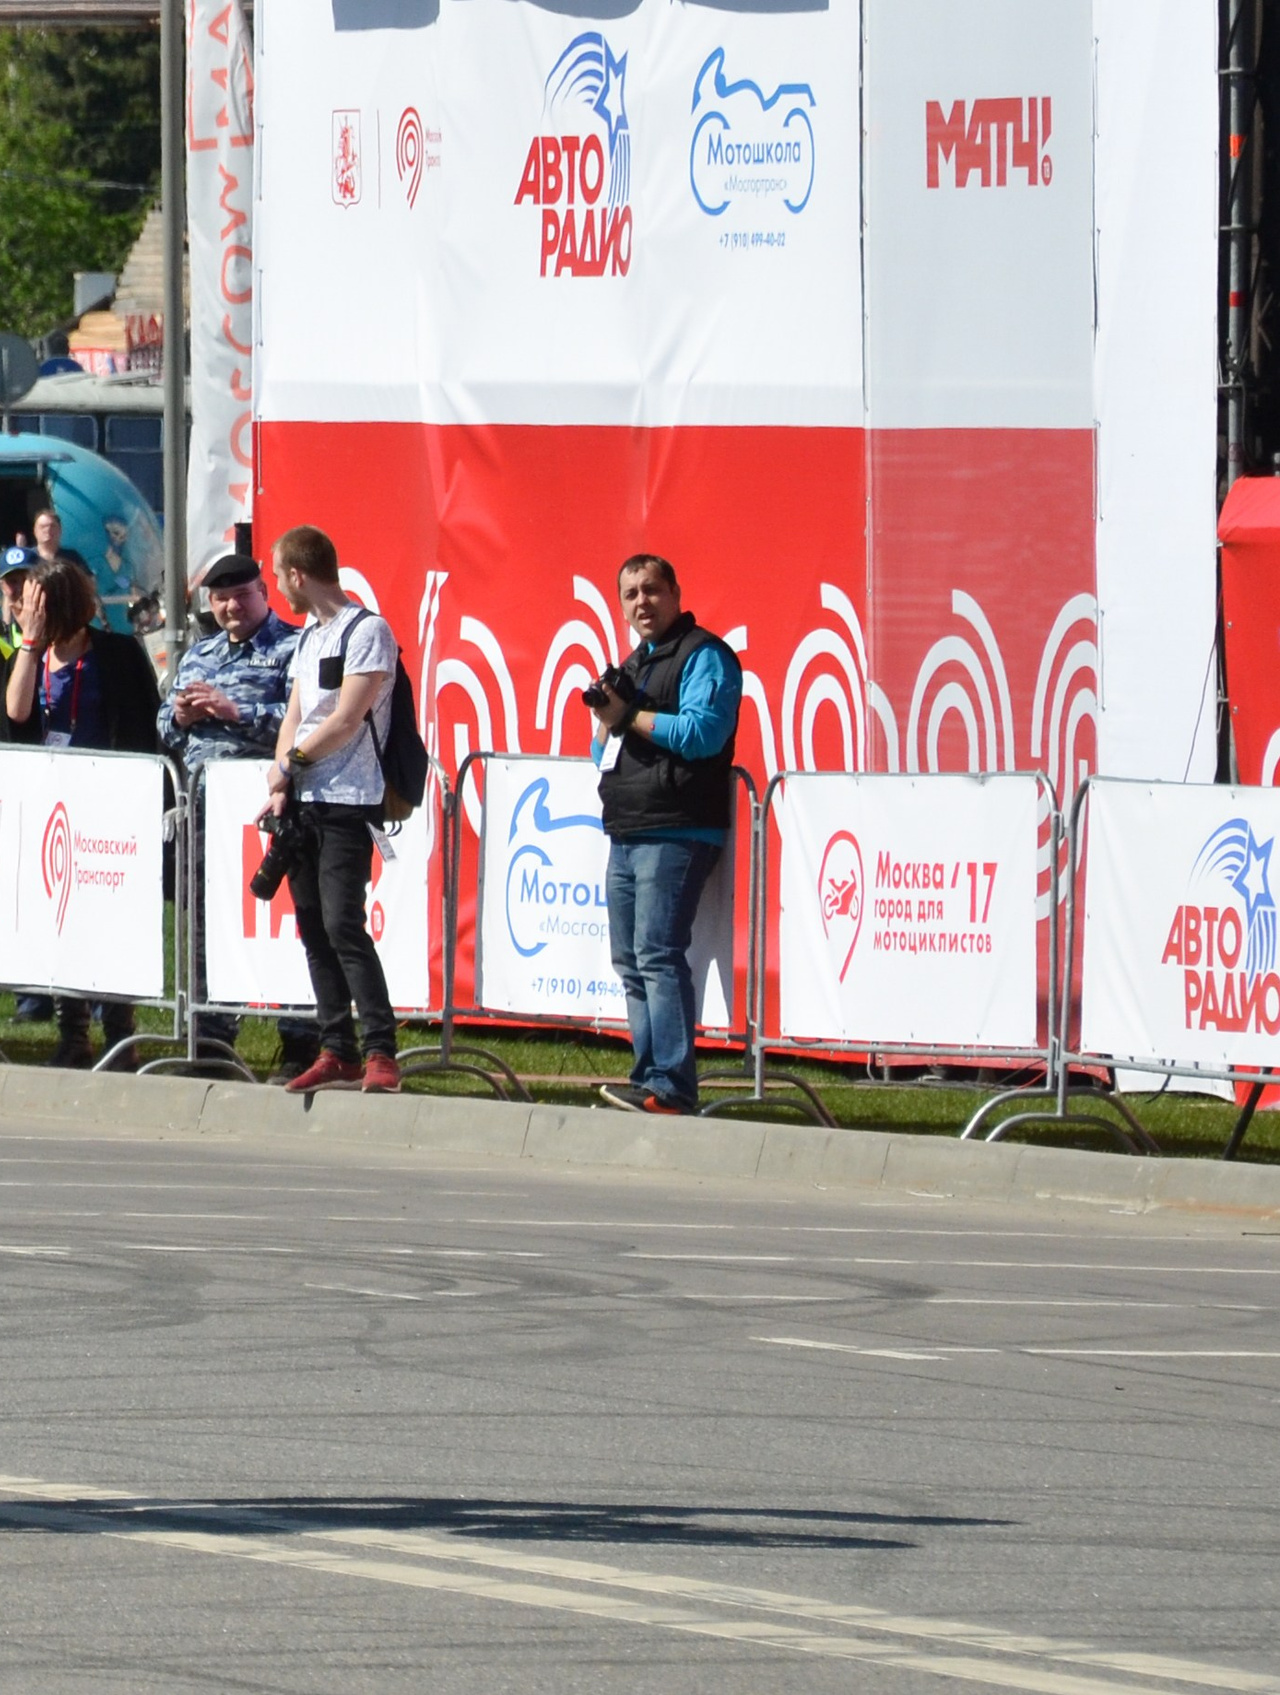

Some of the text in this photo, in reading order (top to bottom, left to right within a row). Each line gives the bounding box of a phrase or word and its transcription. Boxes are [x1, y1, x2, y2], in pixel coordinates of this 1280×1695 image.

[707, 133, 801, 166] Мотошкола
[926, 96, 1052, 188] МАТЧ!
[514, 133, 604, 205] АВТО
[540, 205, 632, 277] РАДИО
[73, 830, 137, 857] Московский
[73, 861, 126, 893] Транспорт
[875, 850, 944, 889] Москва
[874, 898, 944, 928] город для
[873, 930, 992, 956] мотоциклистов
[1161, 905, 1243, 969] АВТО
[531, 977, 544, 992] +7
[546, 977, 582, 999] (910)
[1184, 968, 1280, 1036] РАДИО
